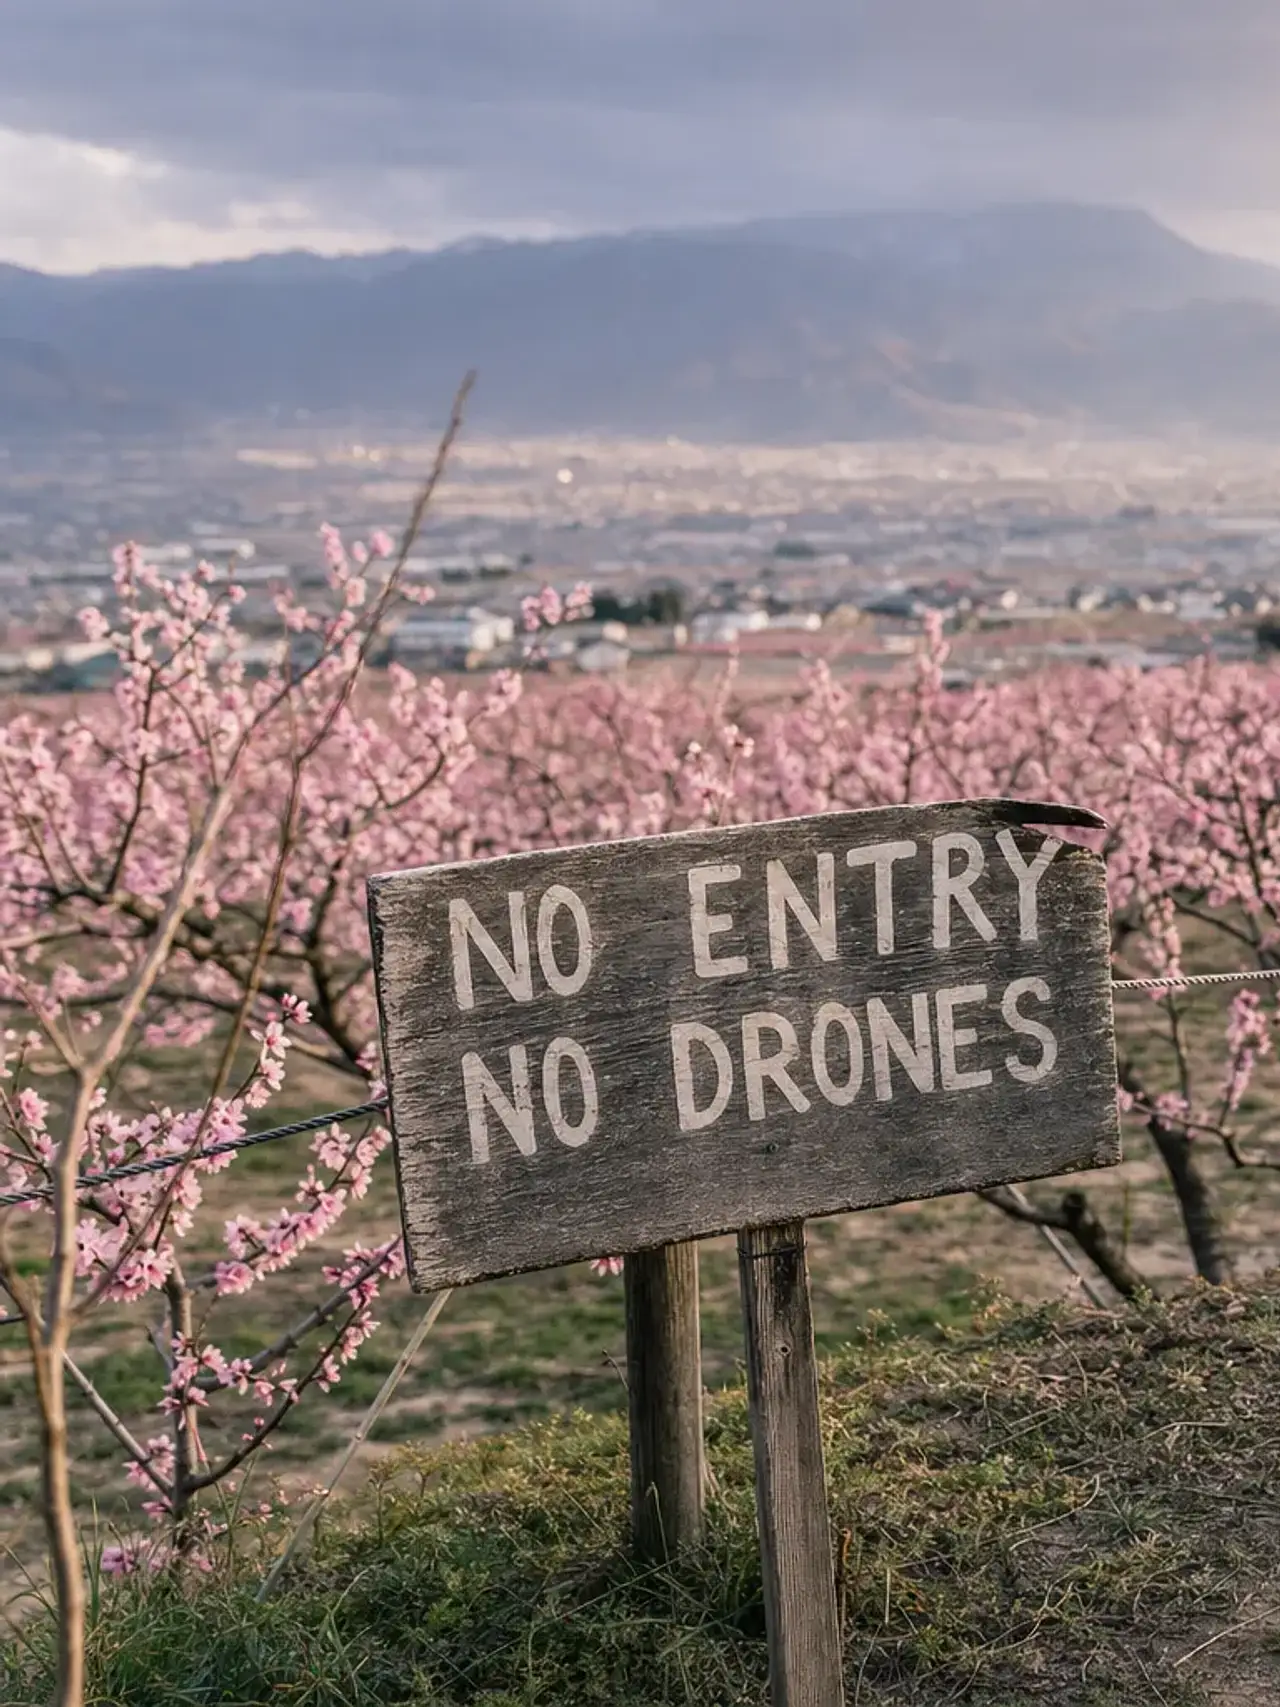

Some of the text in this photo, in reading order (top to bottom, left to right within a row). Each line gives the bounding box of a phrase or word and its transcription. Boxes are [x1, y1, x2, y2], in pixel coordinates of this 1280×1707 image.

[449, 828, 1063, 1010] NO ENTRY
[461, 976, 1058, 1164] NO DRONES
